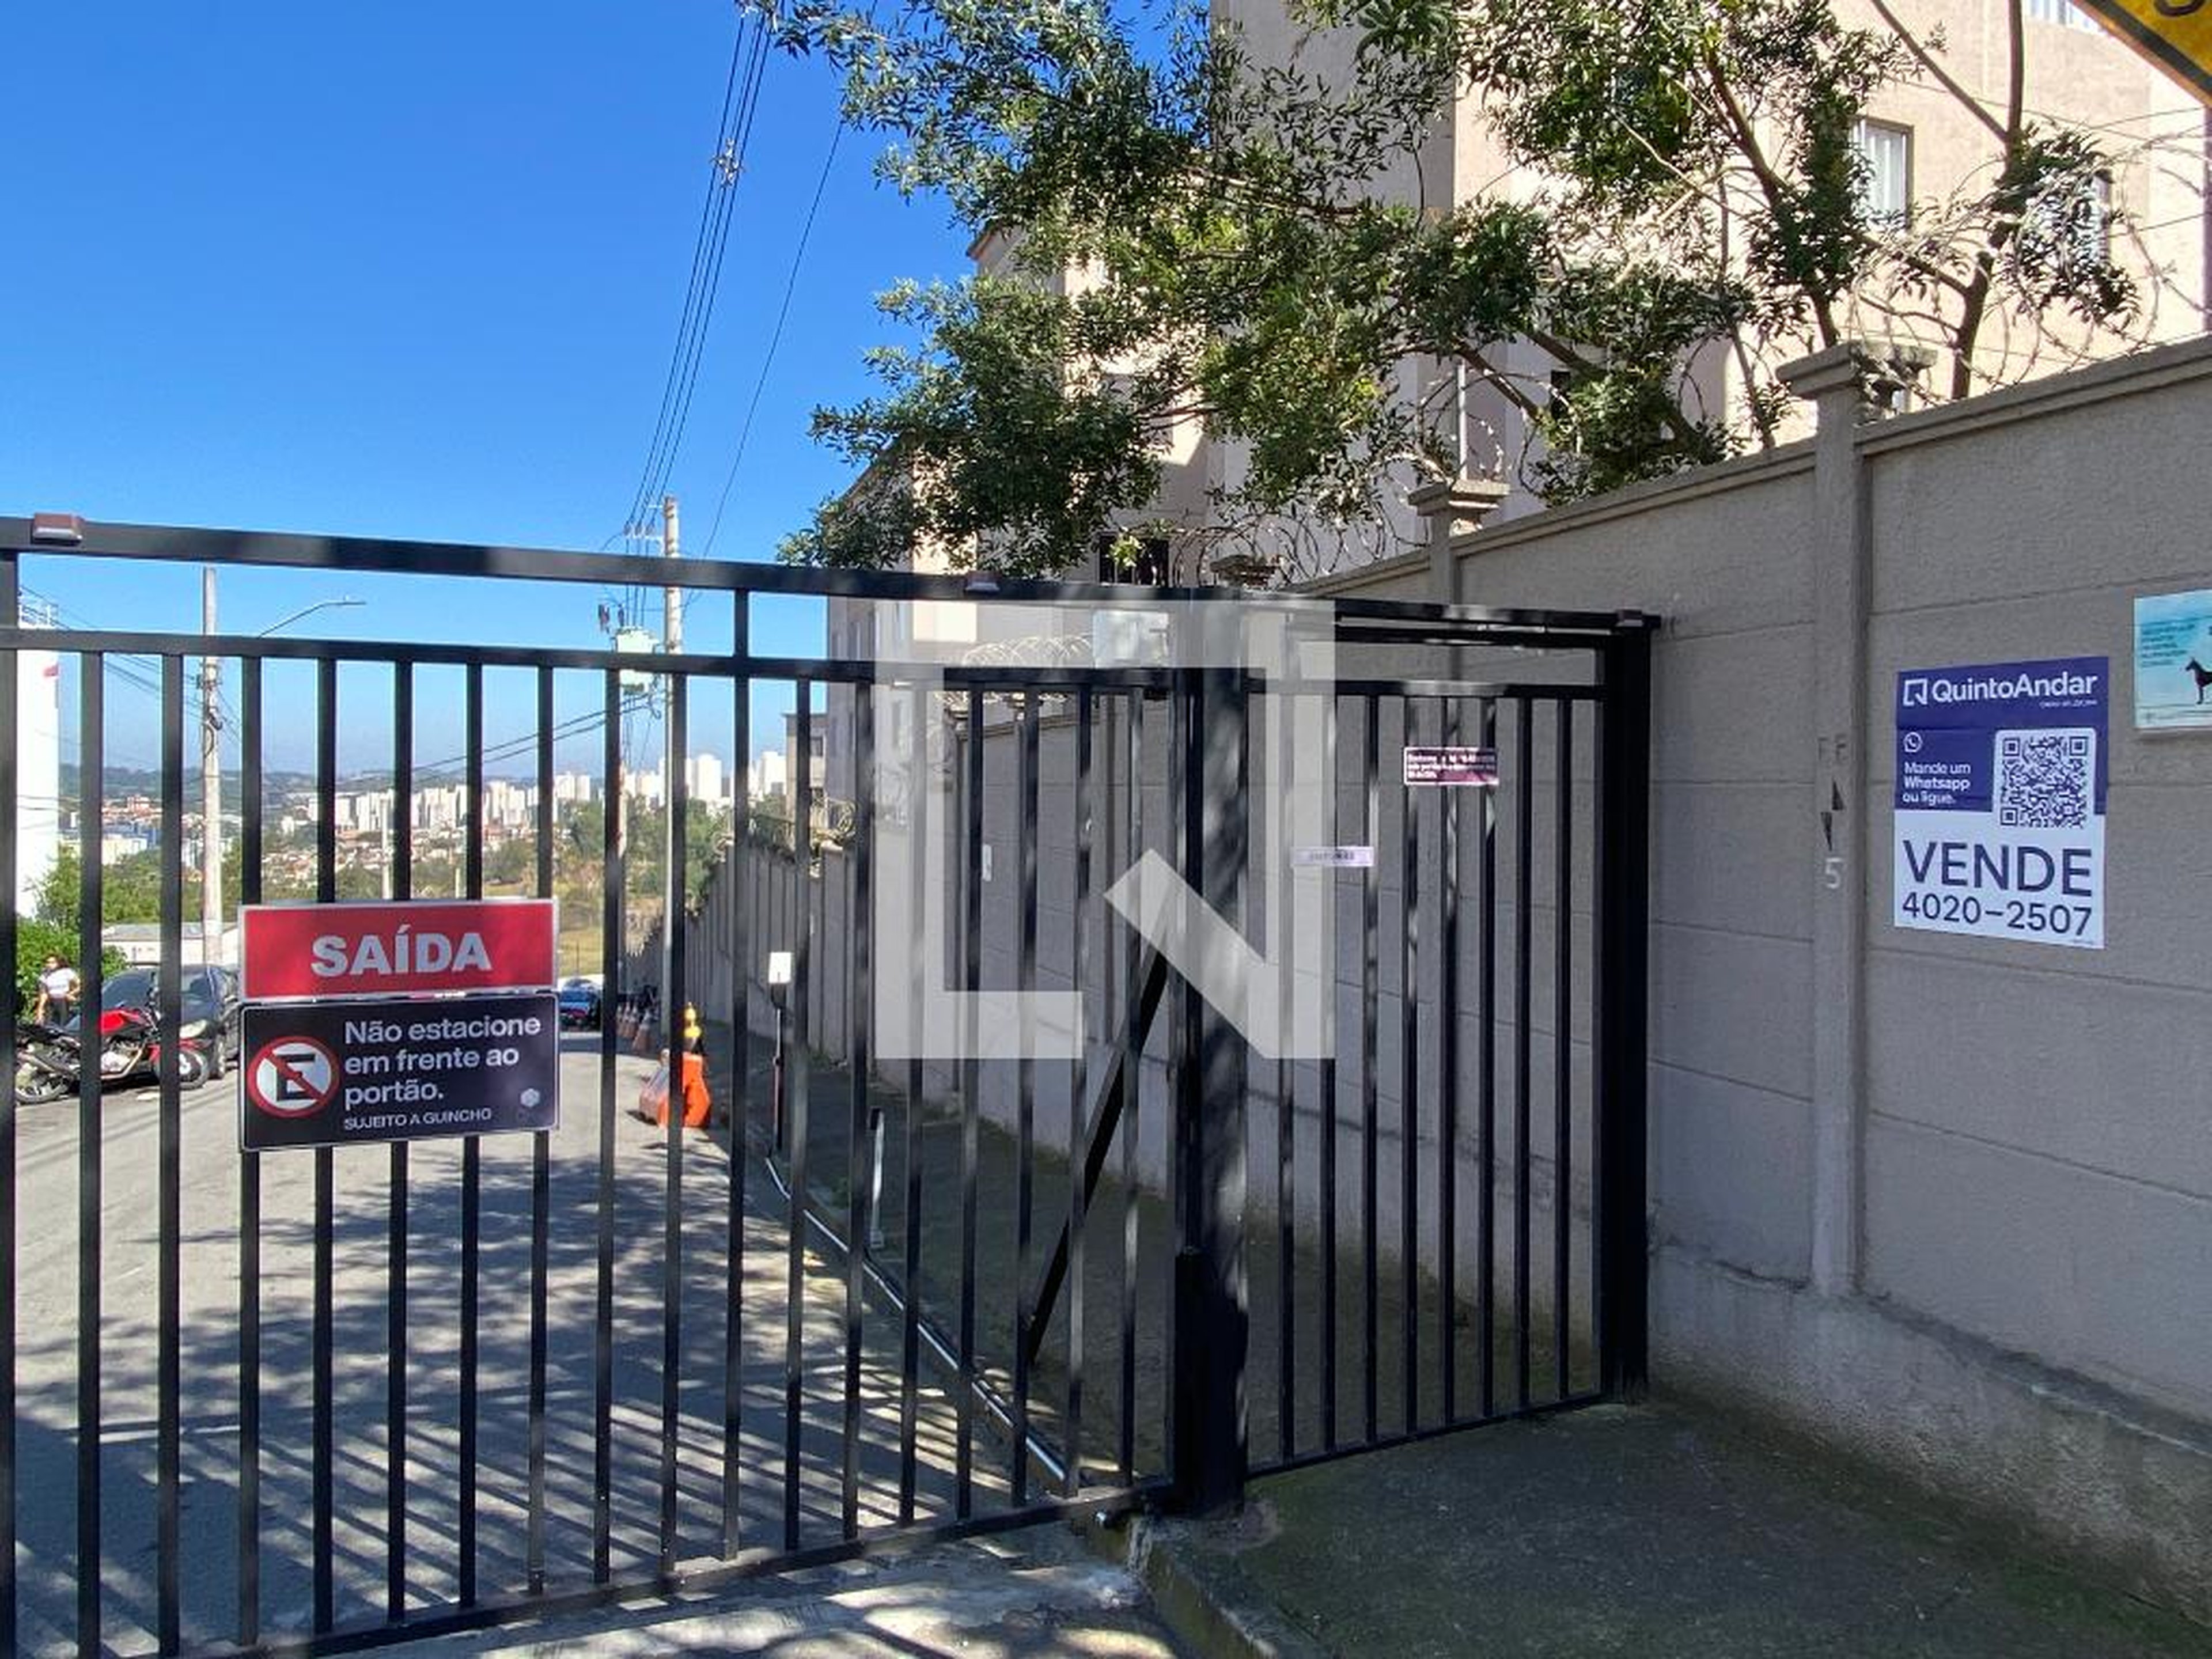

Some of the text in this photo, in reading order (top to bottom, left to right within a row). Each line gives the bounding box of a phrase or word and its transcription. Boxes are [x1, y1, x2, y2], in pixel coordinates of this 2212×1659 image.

[1931, 671, 2099, 703] QuintoAndar
[1949, 764, 1971, 774] um
[1902, 793, 1919, 802] ou
[1825, 857, 1843, 888] 5
[1902, 839, 2092, 897] VENDE
[1902, 891, 2092, 936] 4020-2507
[310, 923, 493, 978] SAÍDA
[345, 1015, 540, 1044] Não estacione
[345, 1047, 520, 1075] em frente ao
[345, 1078, 444, 1110] portão.
[344, 1107, 492, 1131] SUJEITO A GUINCHO
